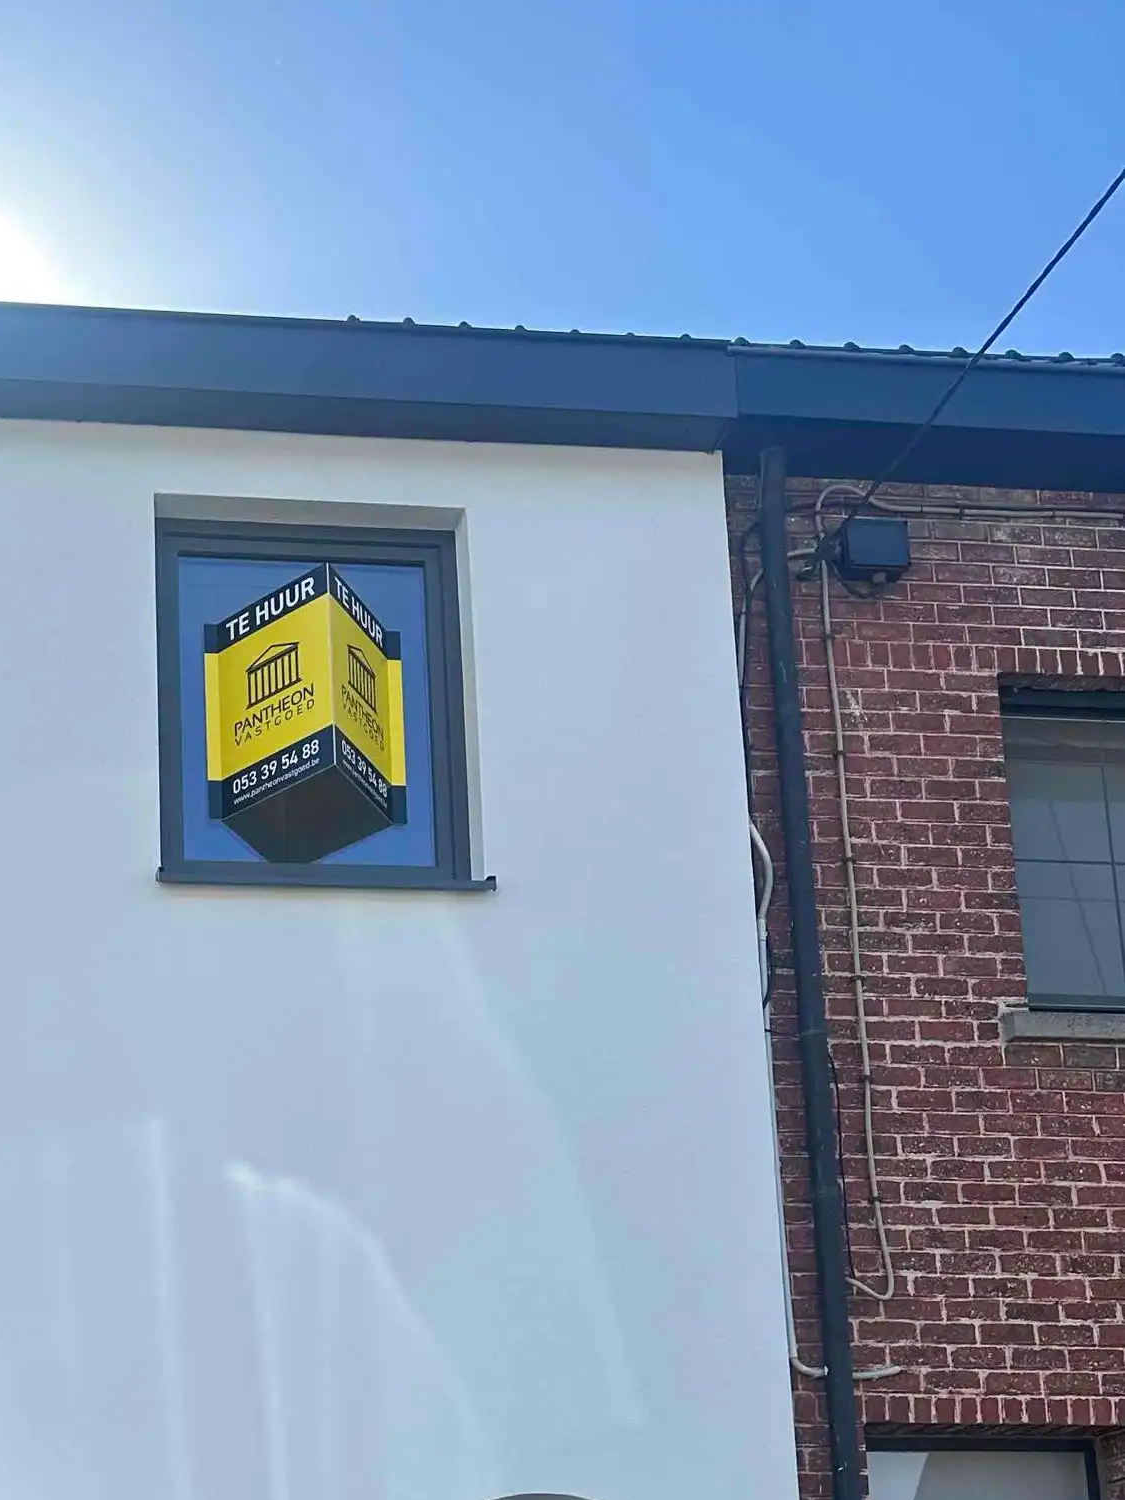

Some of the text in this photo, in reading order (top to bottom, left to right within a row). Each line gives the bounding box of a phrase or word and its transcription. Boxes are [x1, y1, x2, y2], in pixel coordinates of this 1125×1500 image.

[226, 577, 315, 640] TE HUUR
[334, 576, 383, 648] TE HUUR
[234, 682, 315, 736] PANTHEON
[235, 699, 315, 746] VASTGOED
[341, 684, 384, 740] PANTHEON
[232, 739, 319, 794] 053 39 54 88
[341, 740, 388, 797] 053 39 54 88
